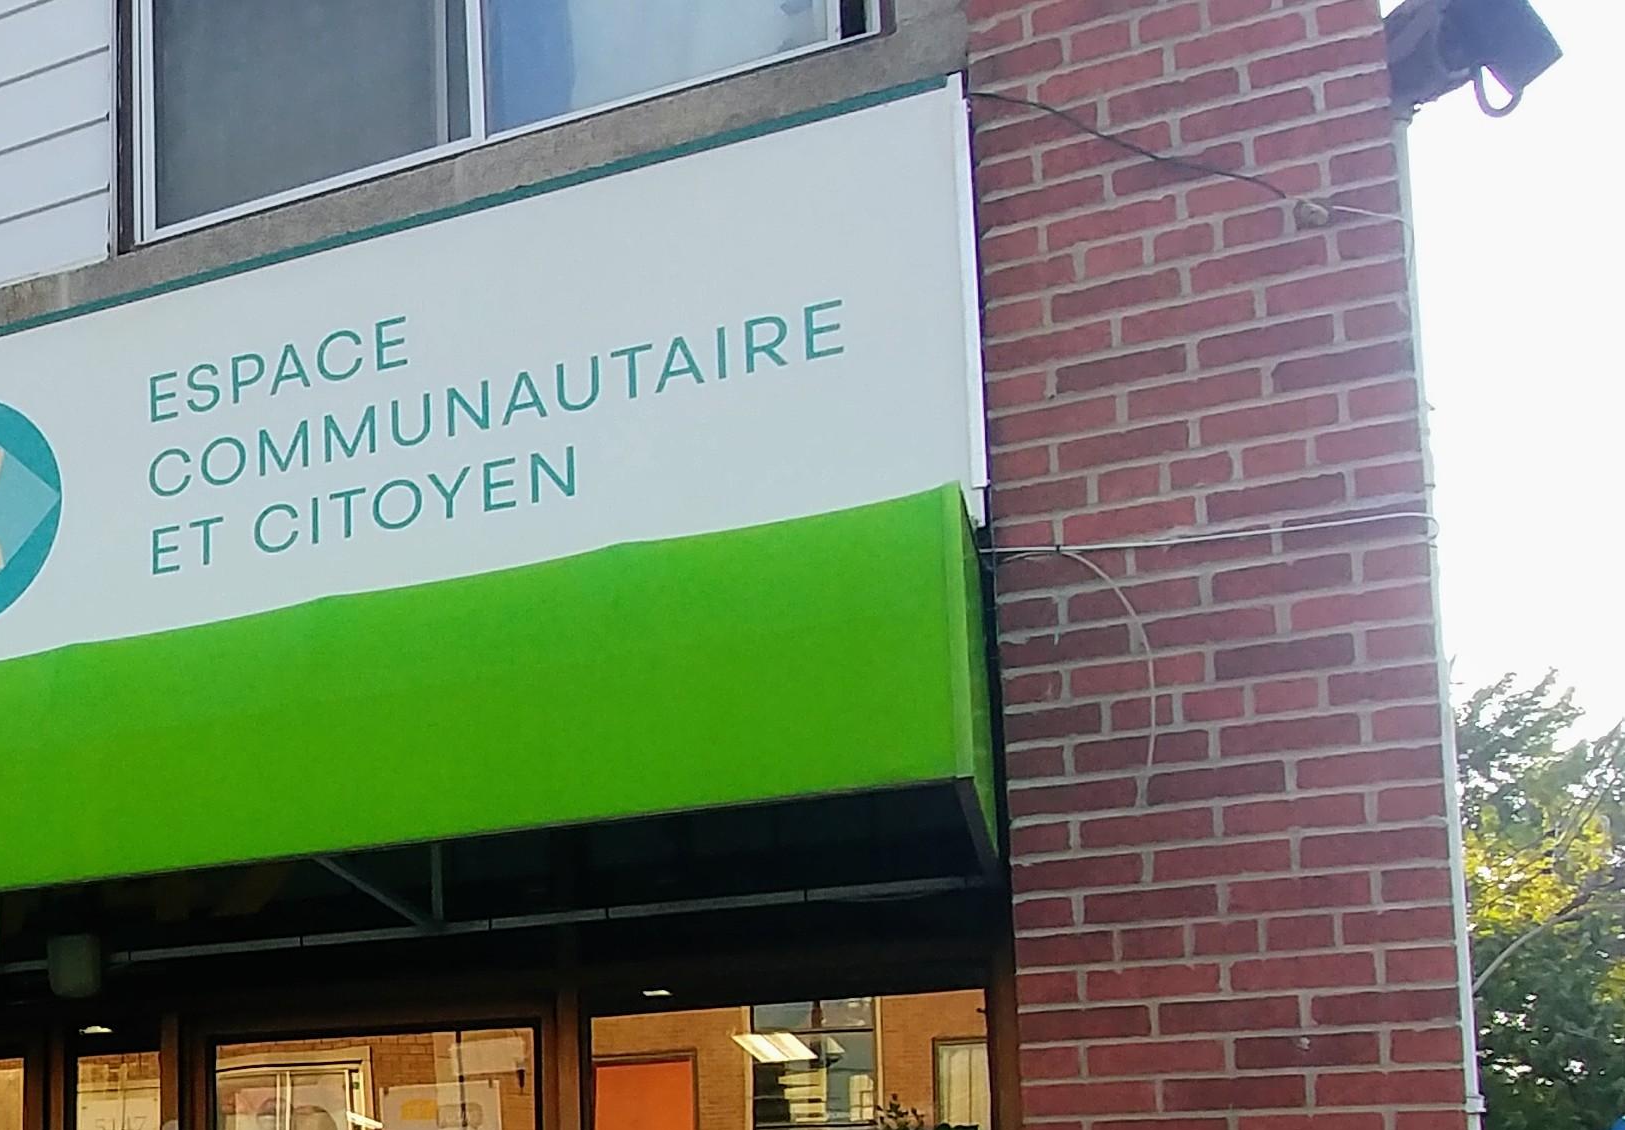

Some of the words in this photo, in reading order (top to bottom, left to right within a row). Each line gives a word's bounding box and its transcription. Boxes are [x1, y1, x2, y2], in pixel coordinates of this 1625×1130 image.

[148, 299, 846, 497] COMMUNAUTAIRE
[149, 315, 409, 423] ESPACE
[151, 516, 224, 576] ET
[253, 446, 577, 554] CITOYEN
